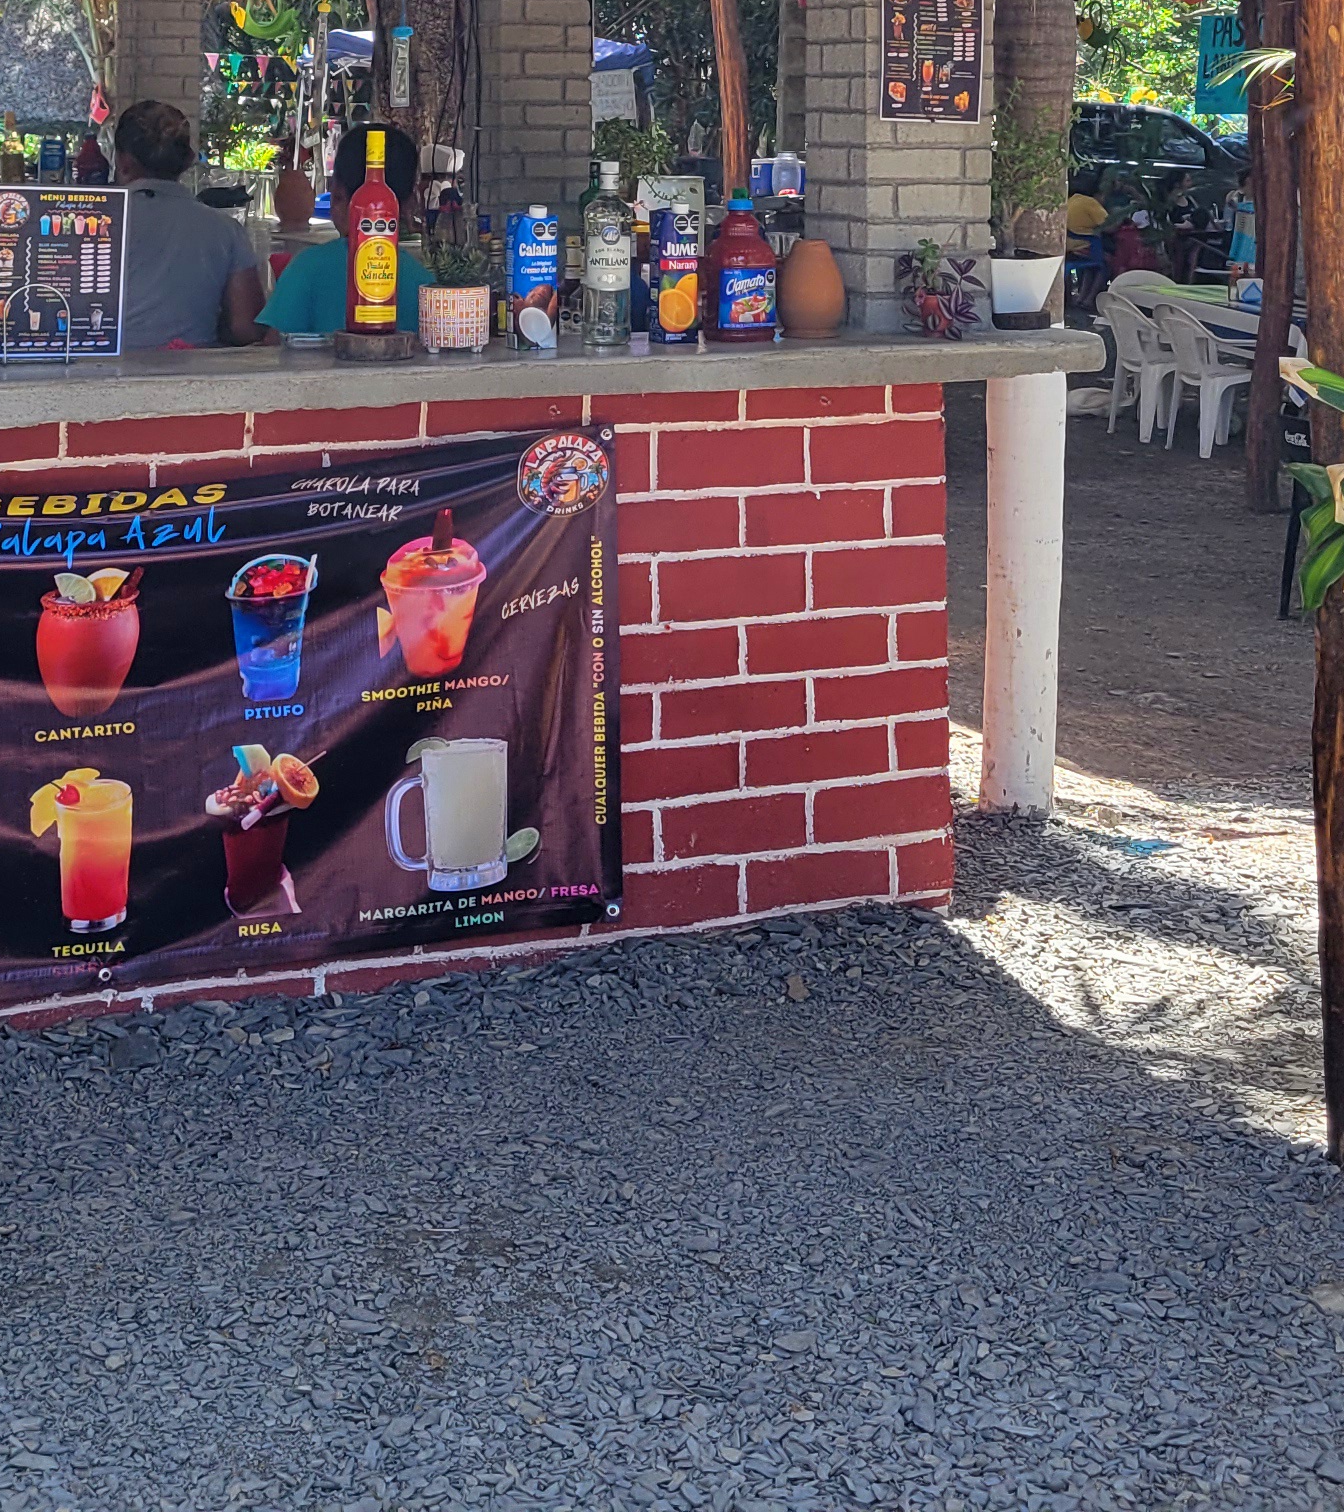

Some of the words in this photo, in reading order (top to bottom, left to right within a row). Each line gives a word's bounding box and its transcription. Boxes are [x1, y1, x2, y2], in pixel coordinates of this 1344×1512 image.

[67, 194, 108, 202] BEBIDAS
[518, 242, 557, 257] Calahu
[662, 242, 698, 257] JUME
[726, 274, 765, 296] Clamato
[291, 474, 370, 497] CHAROLA
[375, 478, 421, 498] PARA
[306, 501, 404, 523] BOTANEAR
[546, 501, 584, 515] DRINKS
[120, 505, 227, 550] Azul
[501, 576, 580, 621] CERVEZAS
[591, 609, 604, 634] SIN
[592, 638, 604, 648] O
[360, 682, 441, 703] SMOOTHIE
[243, 704, 305, 720] PITUFO
[416, 696, 454, 714] PIÑA
[593, 691, 606, 742] BEBIDA
[34, 721, 136, 743] CANTARITO
[593, 745, 607, 825] CUALQUIER
[359, 899, 454, 922] MARGARITA
[457, 896, 477, 910] DE
[550, 883, 600, 898] FRESA
[454, 910, 505, 928] LIMON
[238, 922, 283, 938] RUSA
[51, 941, 126, 958] TEQUILA
